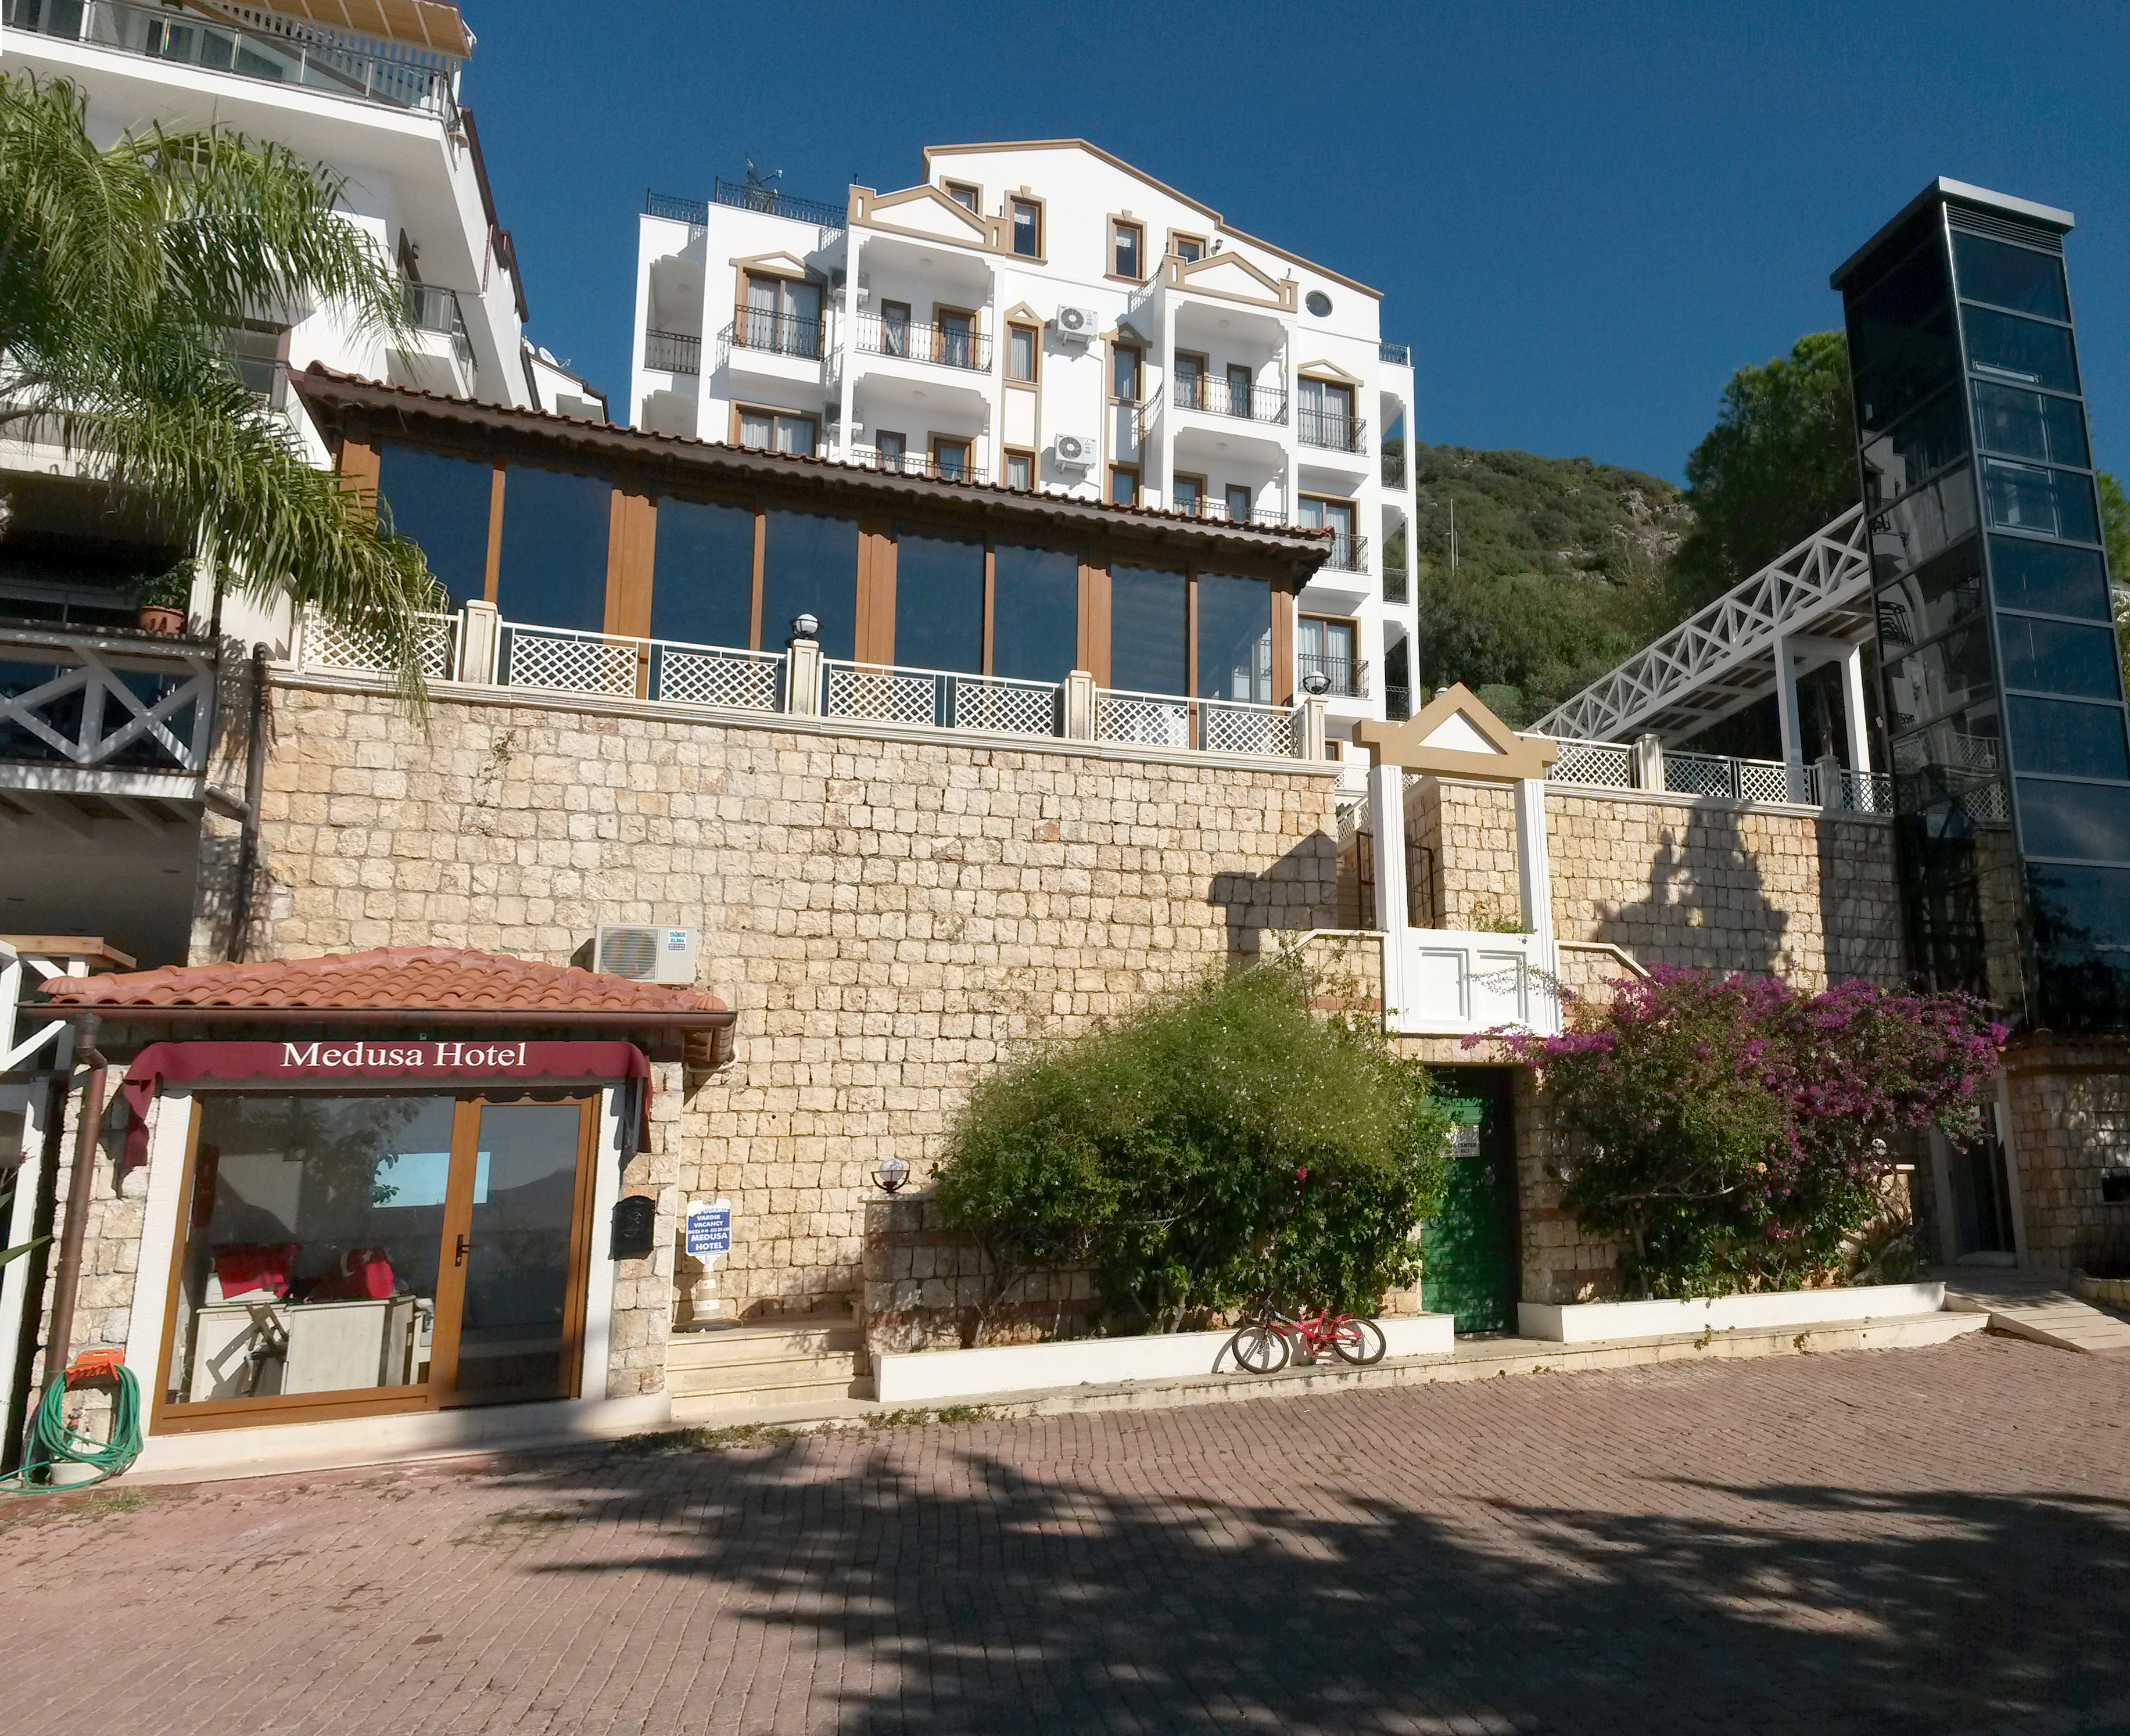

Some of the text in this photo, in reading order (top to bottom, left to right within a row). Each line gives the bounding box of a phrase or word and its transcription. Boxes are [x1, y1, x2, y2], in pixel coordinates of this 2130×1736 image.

[280, 1042, 527, 1067] Medusa Hotel
[691, 1232, 728, 1242] MEDUSA
[695, 1242, 724, 1251] HOTEL
